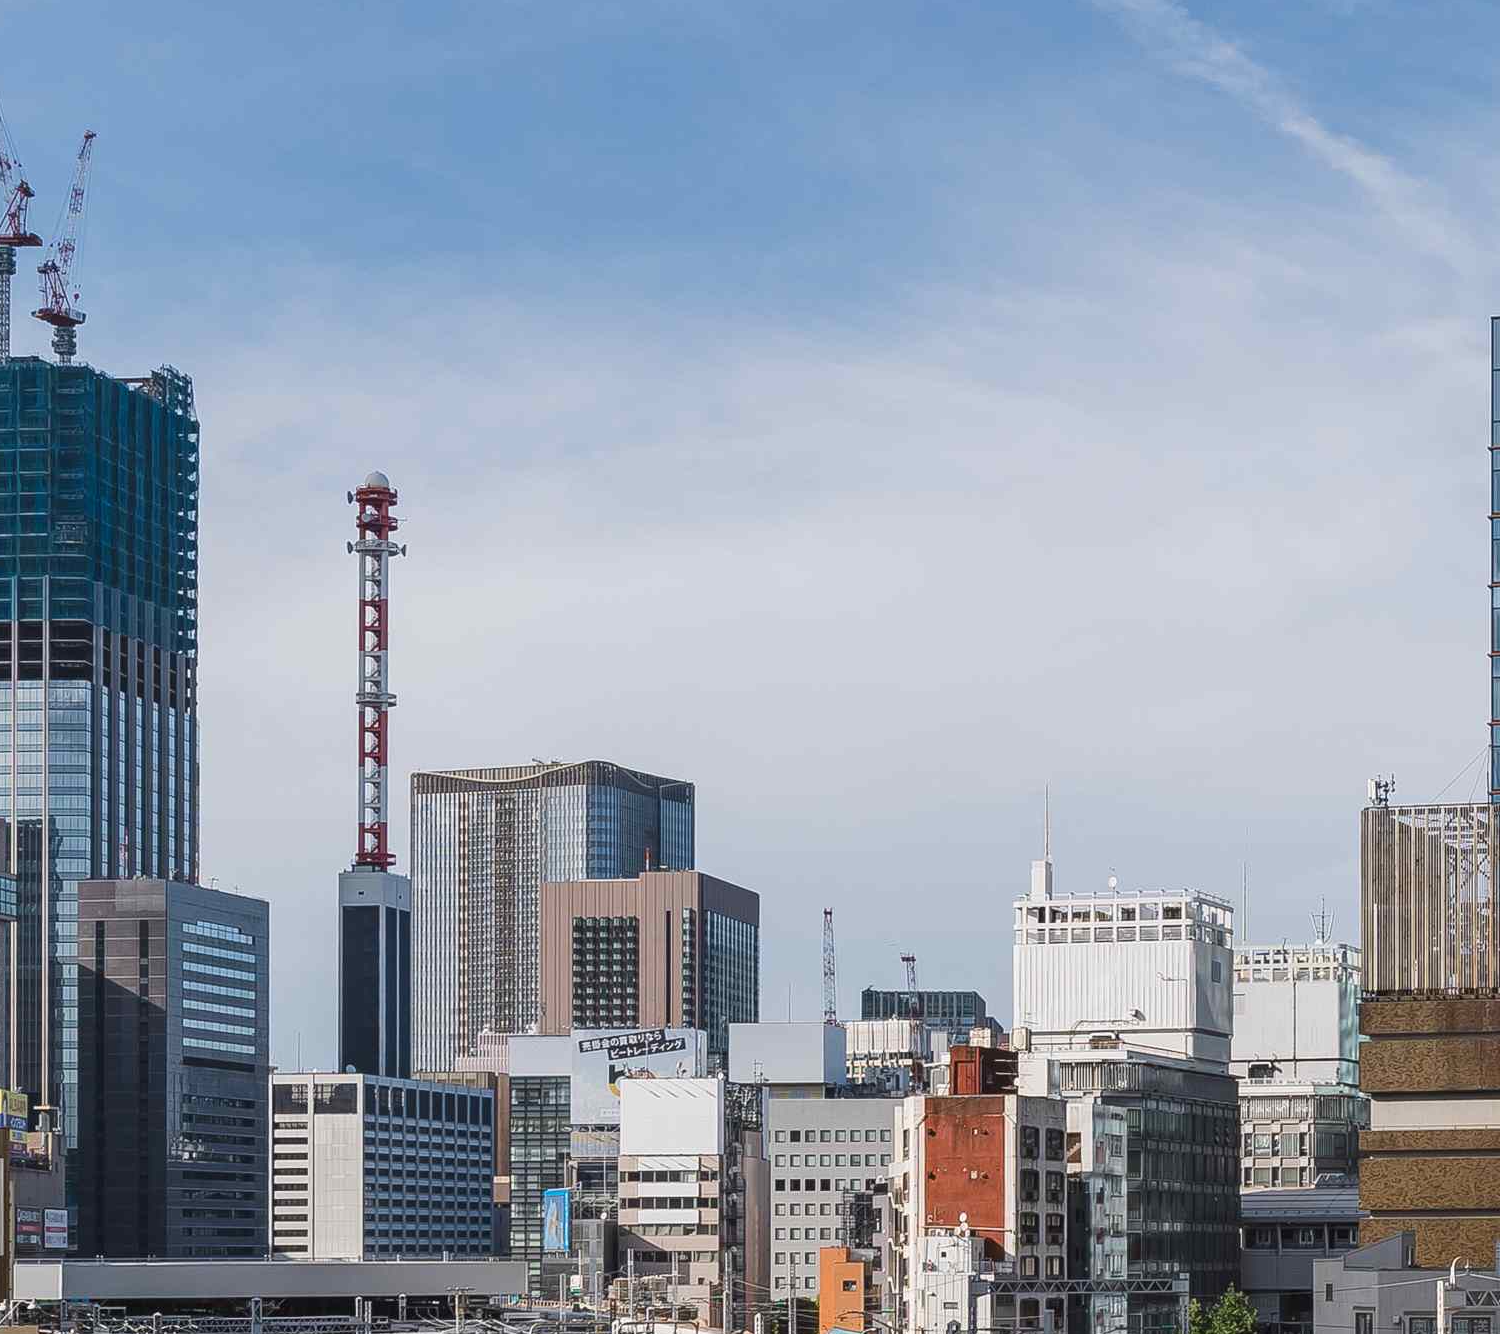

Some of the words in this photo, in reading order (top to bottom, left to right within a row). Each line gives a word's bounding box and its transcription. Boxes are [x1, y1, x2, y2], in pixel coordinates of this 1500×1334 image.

[610, 1040, 682, 1059] ビートレーディング
